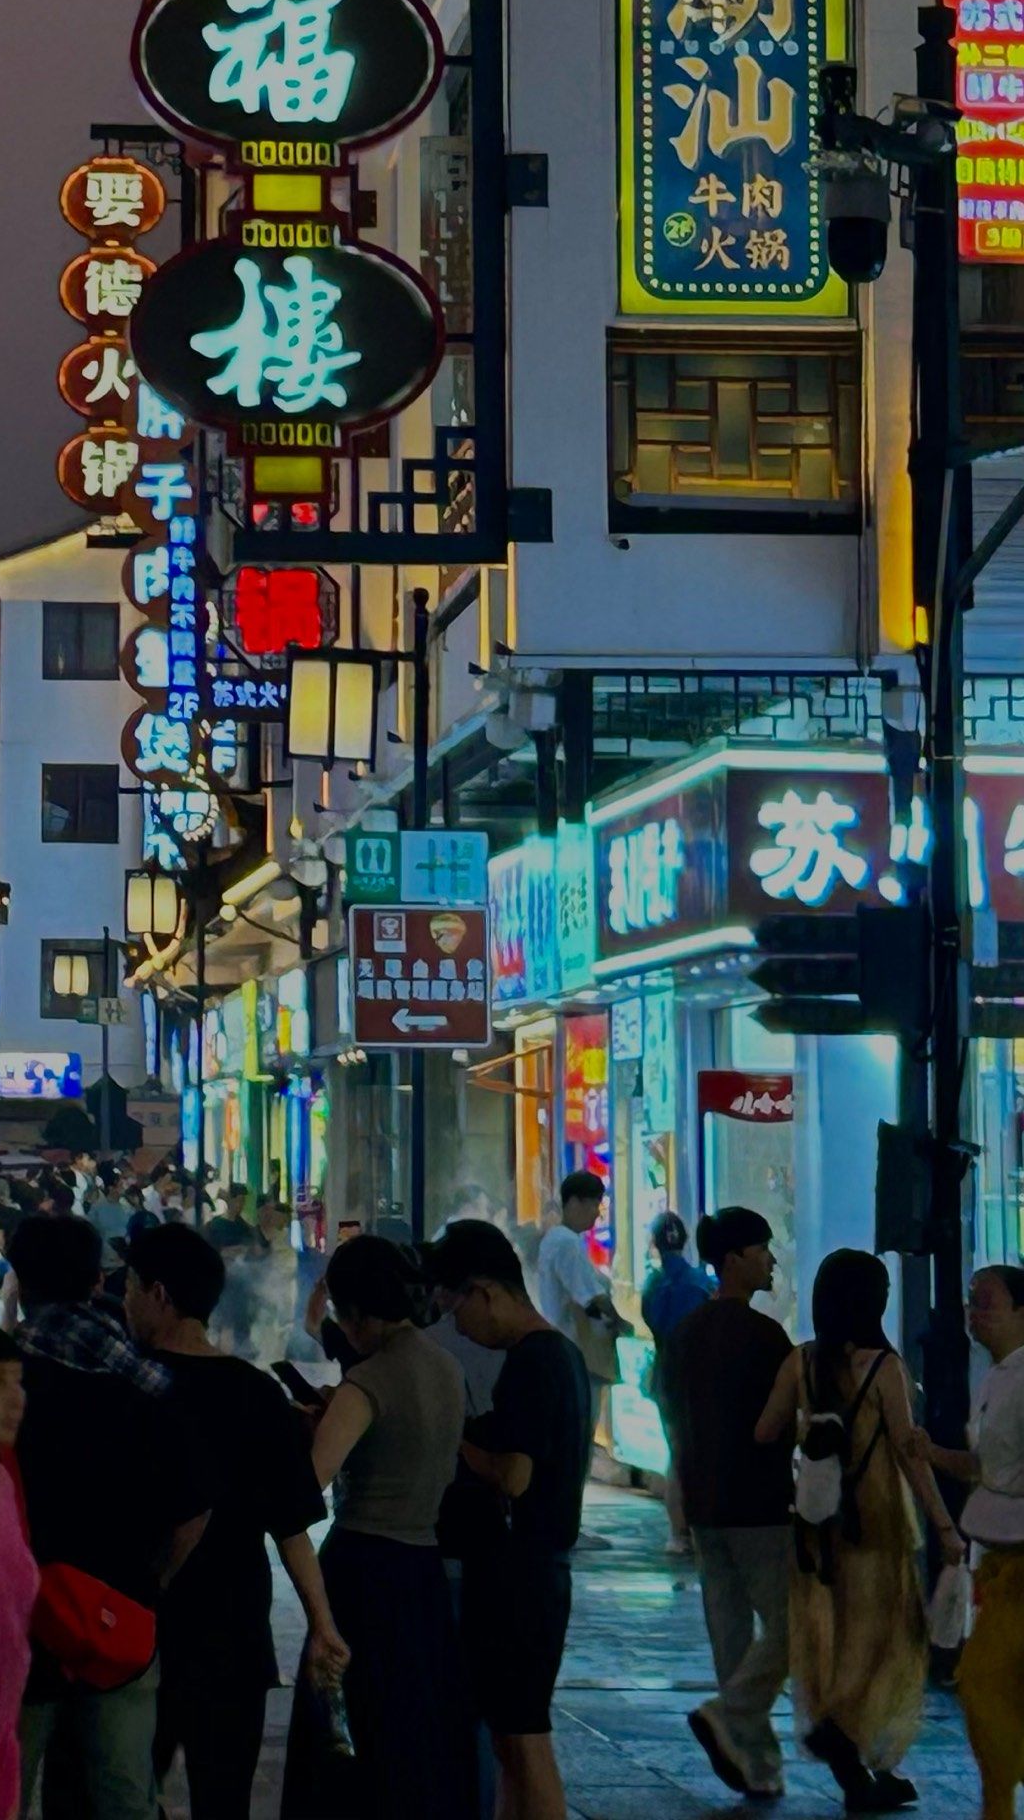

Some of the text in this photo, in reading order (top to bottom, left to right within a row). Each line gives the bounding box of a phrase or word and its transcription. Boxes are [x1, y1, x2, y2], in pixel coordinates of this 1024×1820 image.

[687, 173, 783, 219] 牛肉
[693, 226, 791, 272] 火锅
[82, 172, 144, 498] 要德火锅
[211, 680, 286, 708] 苏式火
